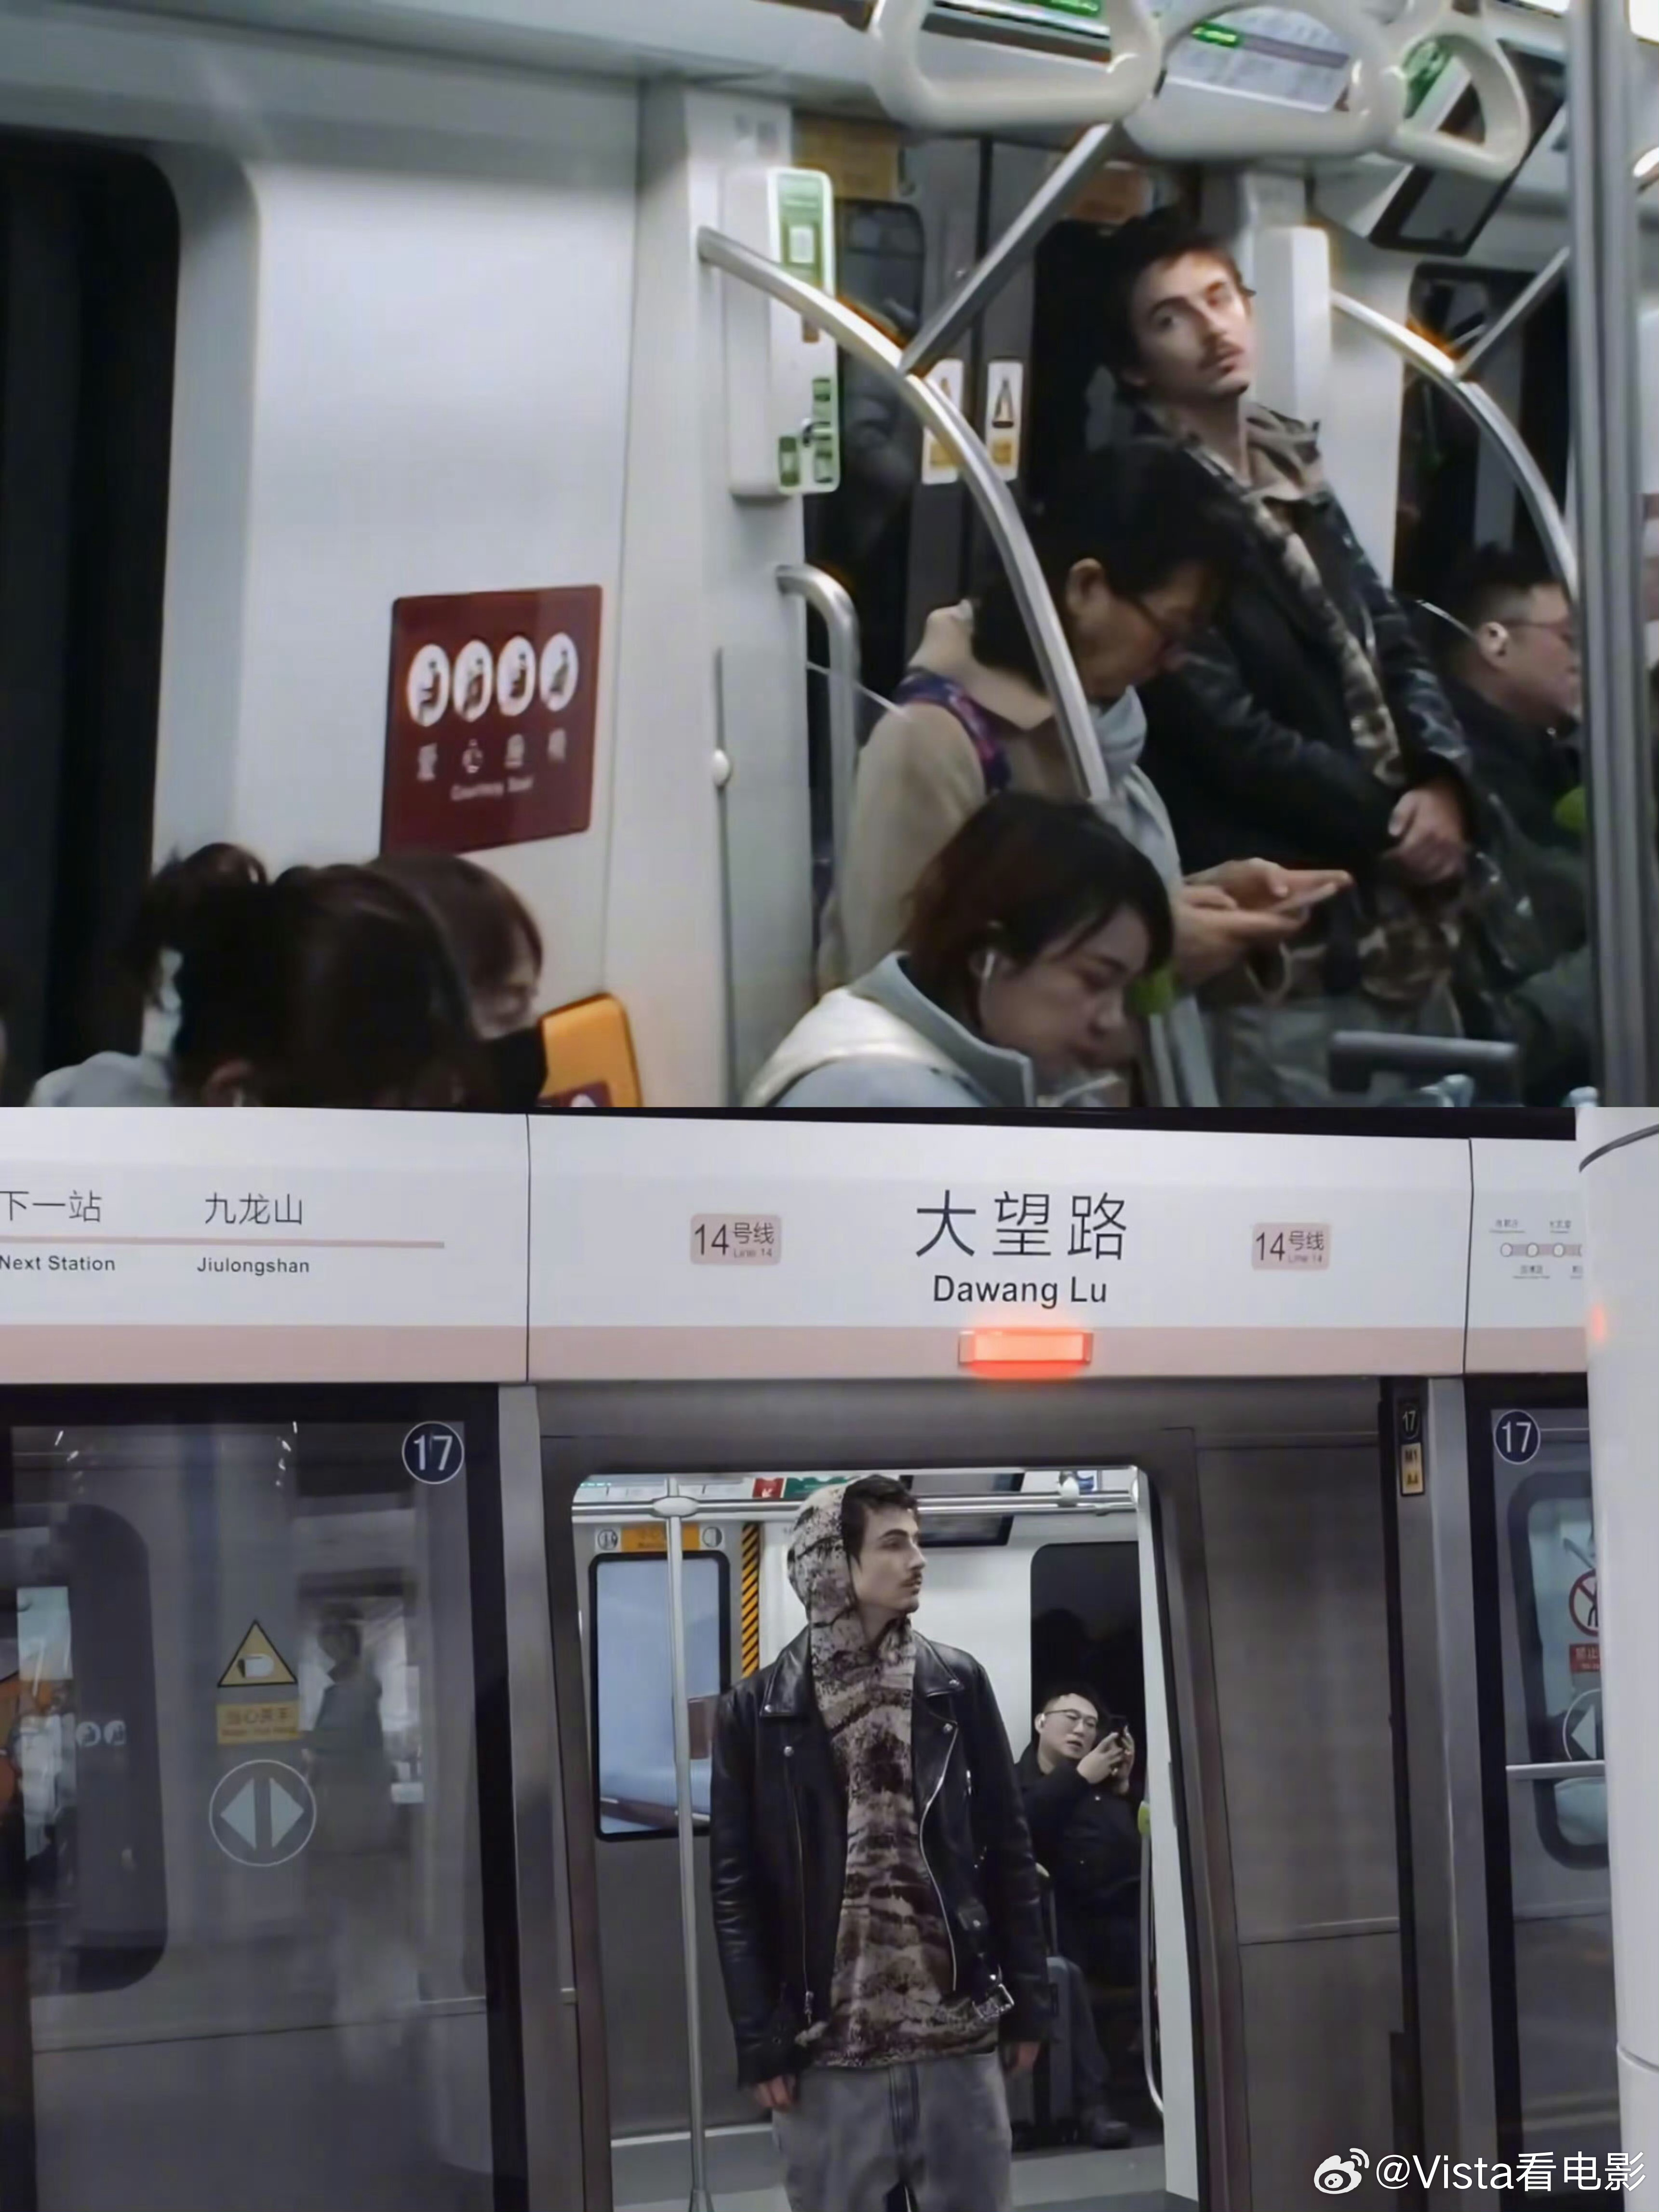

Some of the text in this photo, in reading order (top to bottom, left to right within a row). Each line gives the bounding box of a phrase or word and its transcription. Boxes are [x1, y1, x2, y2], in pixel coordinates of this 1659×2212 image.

[0, 1190, 102, 1222] 下一站
[205, 1192, 302, 1225] 九龙山
[695, 1222, 775, 1256] 14号线
[916, 1189, 1127, 1260] 大望路
[1256, 1230, 1325, 1262] 14号线
[0, 1255, 116, 1271] Next Station
[197, 1256, 309, 1277] Jiulongshan
[934, 1275, 1107, 1309] Dawang Lu
[1402, 1410, 1416, 1432] 17
[1501, 1421, 1532, 1453] 17
[413, 1434, 453, 1471] 17
